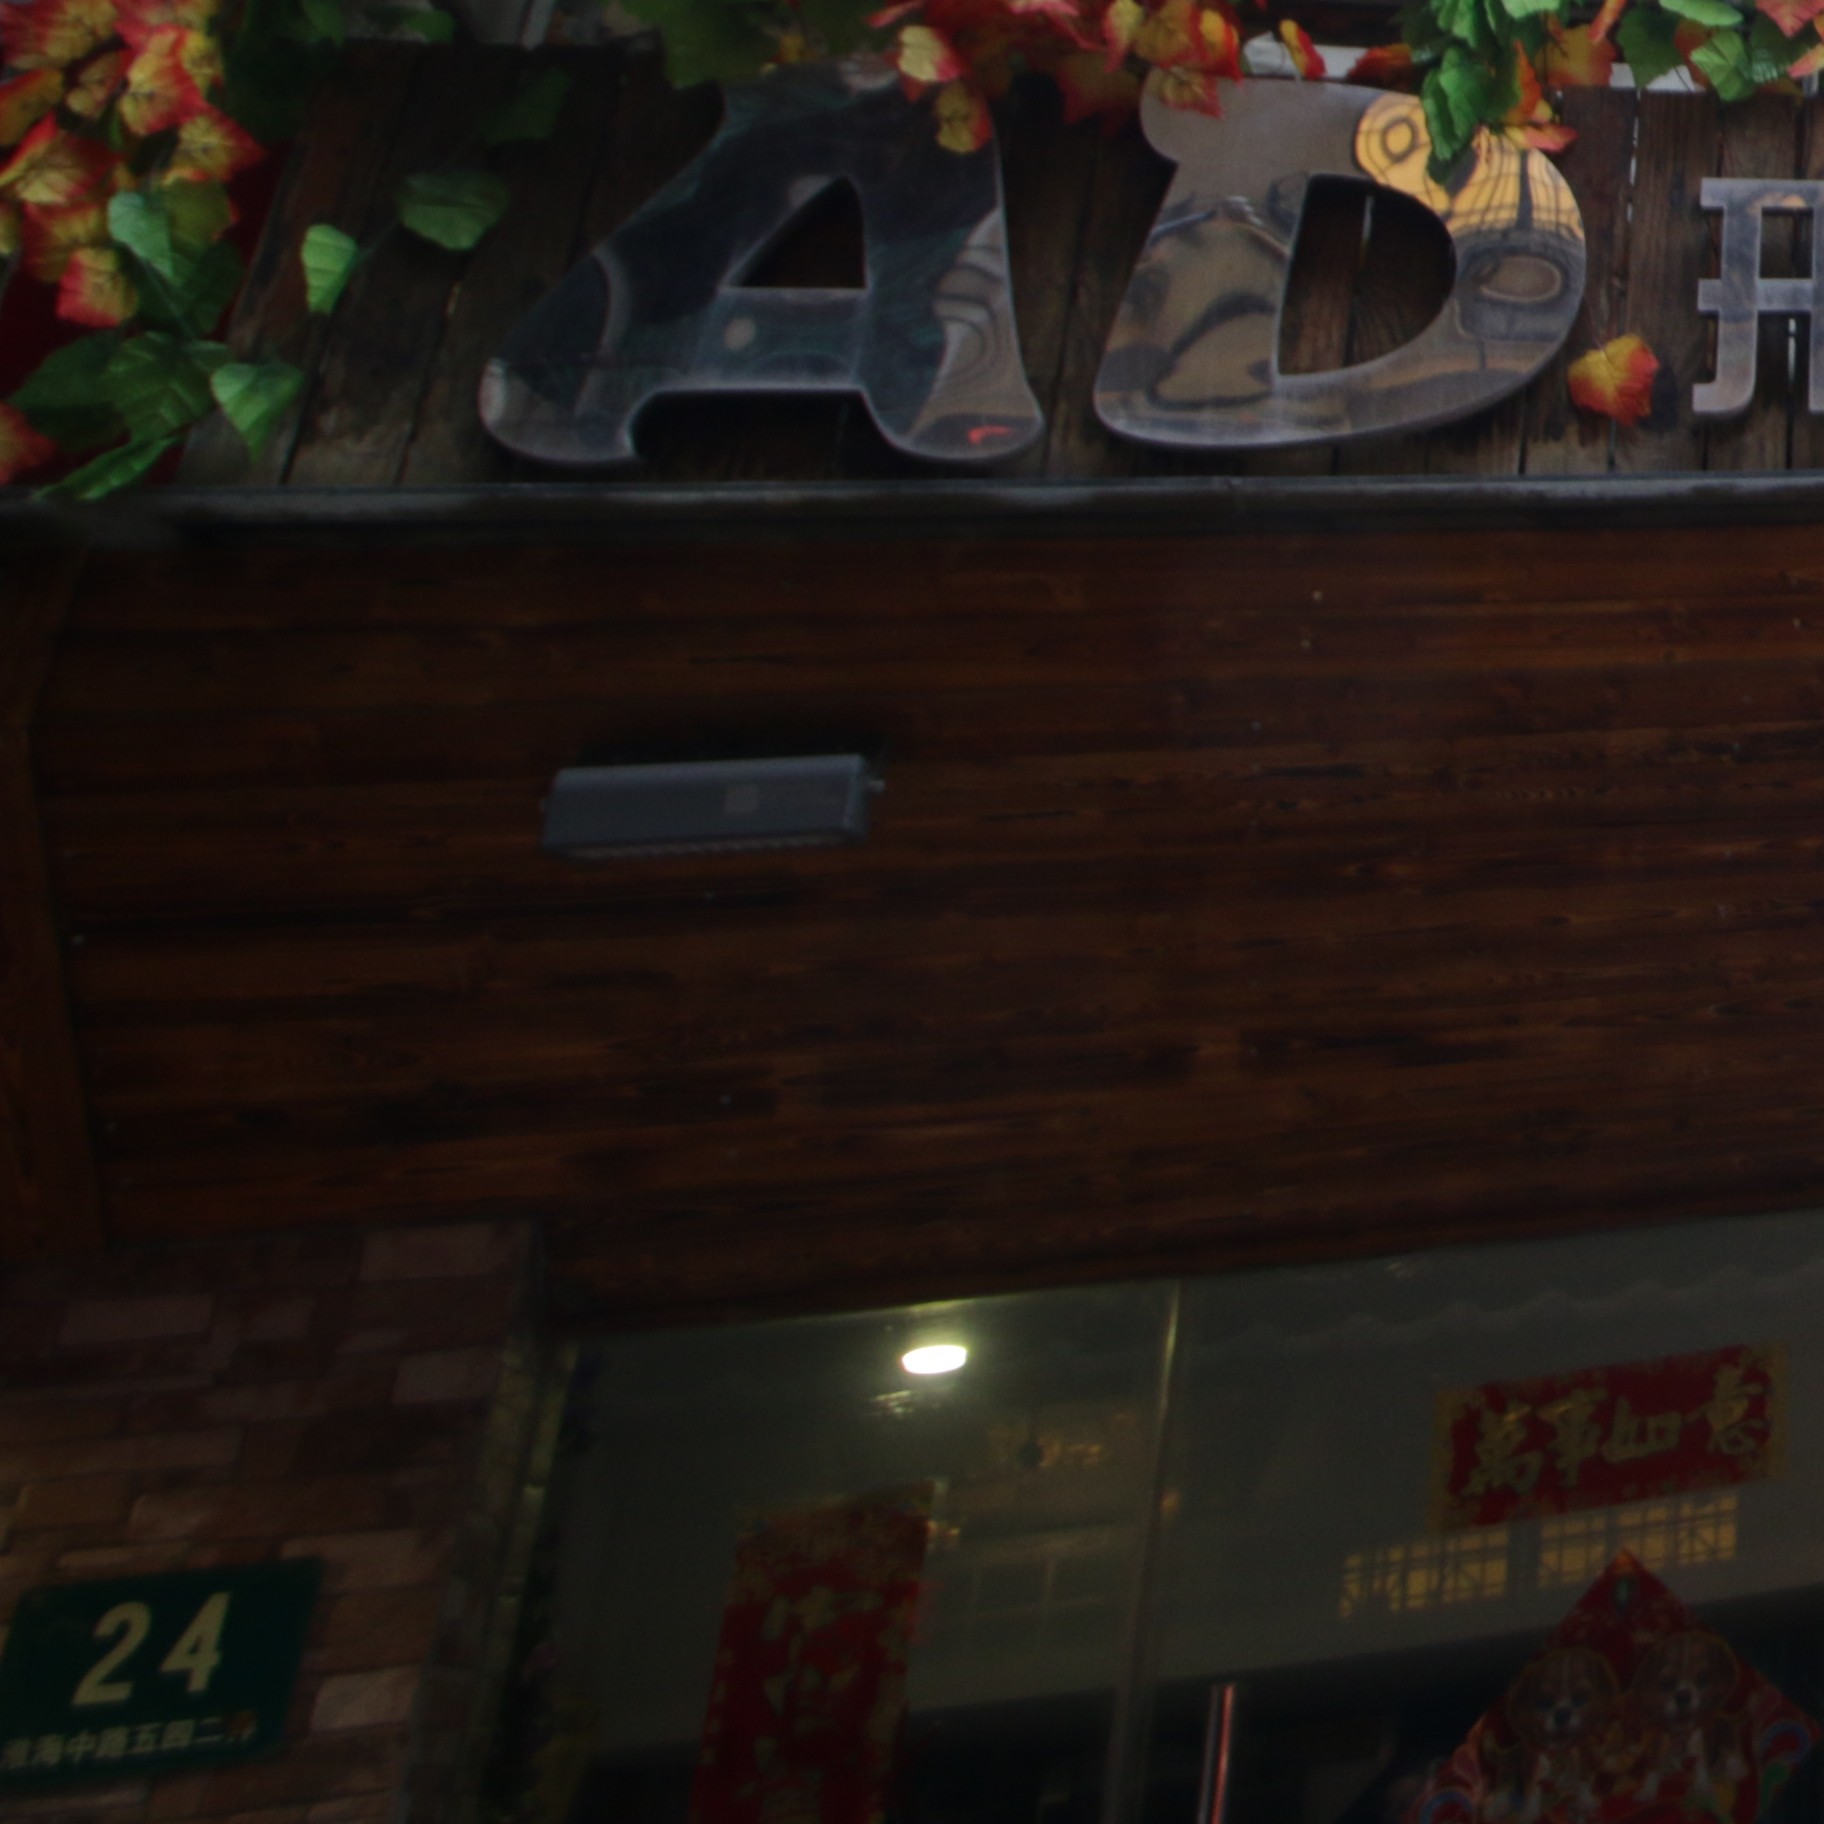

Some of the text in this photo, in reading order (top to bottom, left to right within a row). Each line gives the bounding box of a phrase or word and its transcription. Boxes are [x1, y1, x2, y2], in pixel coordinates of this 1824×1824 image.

[478, 52, 1586, 462] AD
[1460, 1363, 1770, 1498] 萬事如意
[70, 1589, 233, 1707] 24
